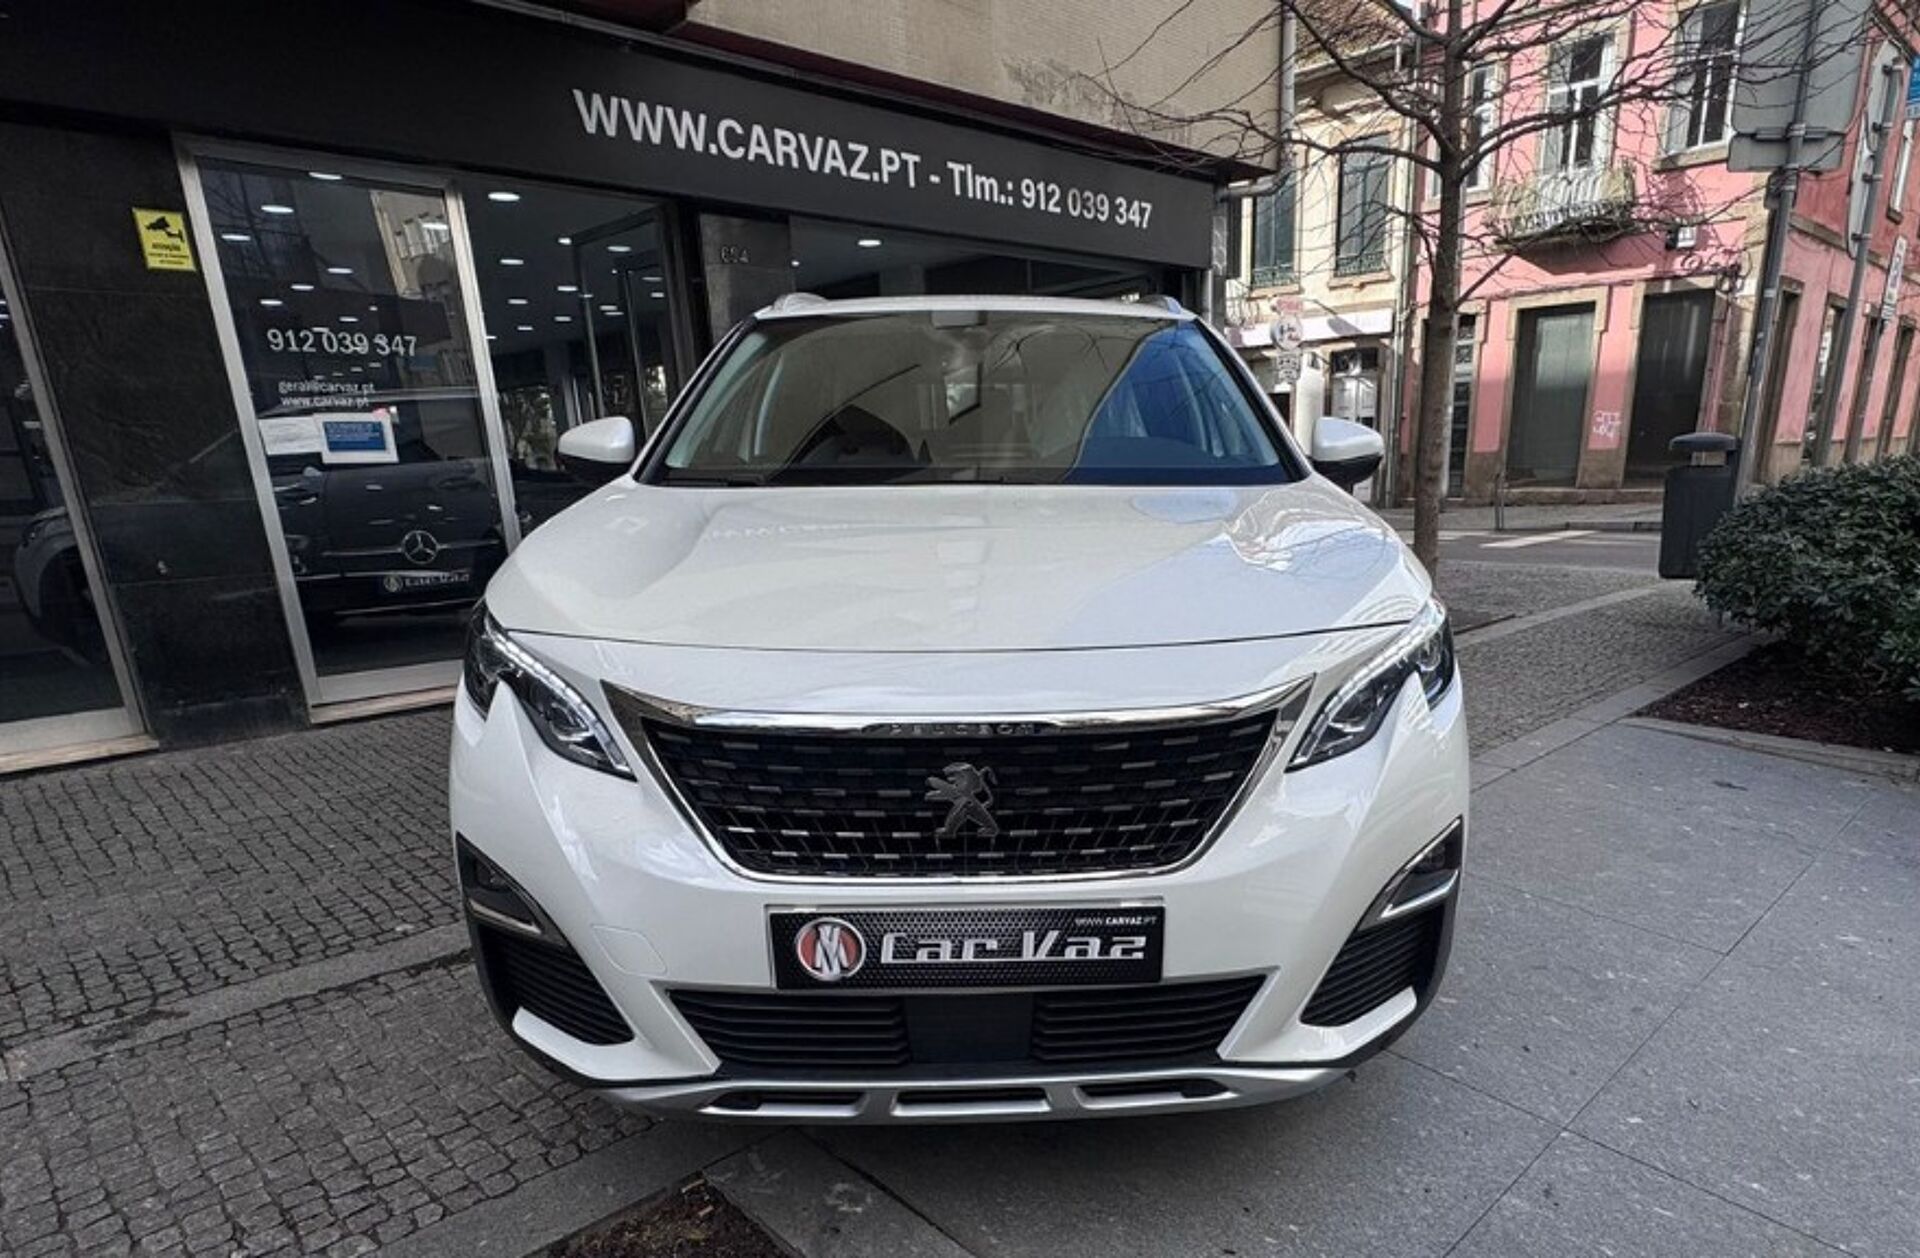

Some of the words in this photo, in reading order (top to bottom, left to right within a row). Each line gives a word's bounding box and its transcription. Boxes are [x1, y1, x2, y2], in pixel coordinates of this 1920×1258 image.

[572, 88, 921, 189] WWW.CARVAZ.PT
[946, 161, 1014, 206] Tlm.:
[1020, 178, 1062, 214] 912
[1067, 188, 1110, 223] 039
[1114, 196, 1153, 230] 347
[266, 328, 316, 352] 912
[320, 330, 369, 355] 039
[373, 333, 418, 357] 347
[278, 378, 376, 395] geral@carvaz.pt
[280, 395, 370, 409] www.carvaz.pt
[880, 931, 999, 964] Car
[1021, 929, 1147, 961] Vaz
